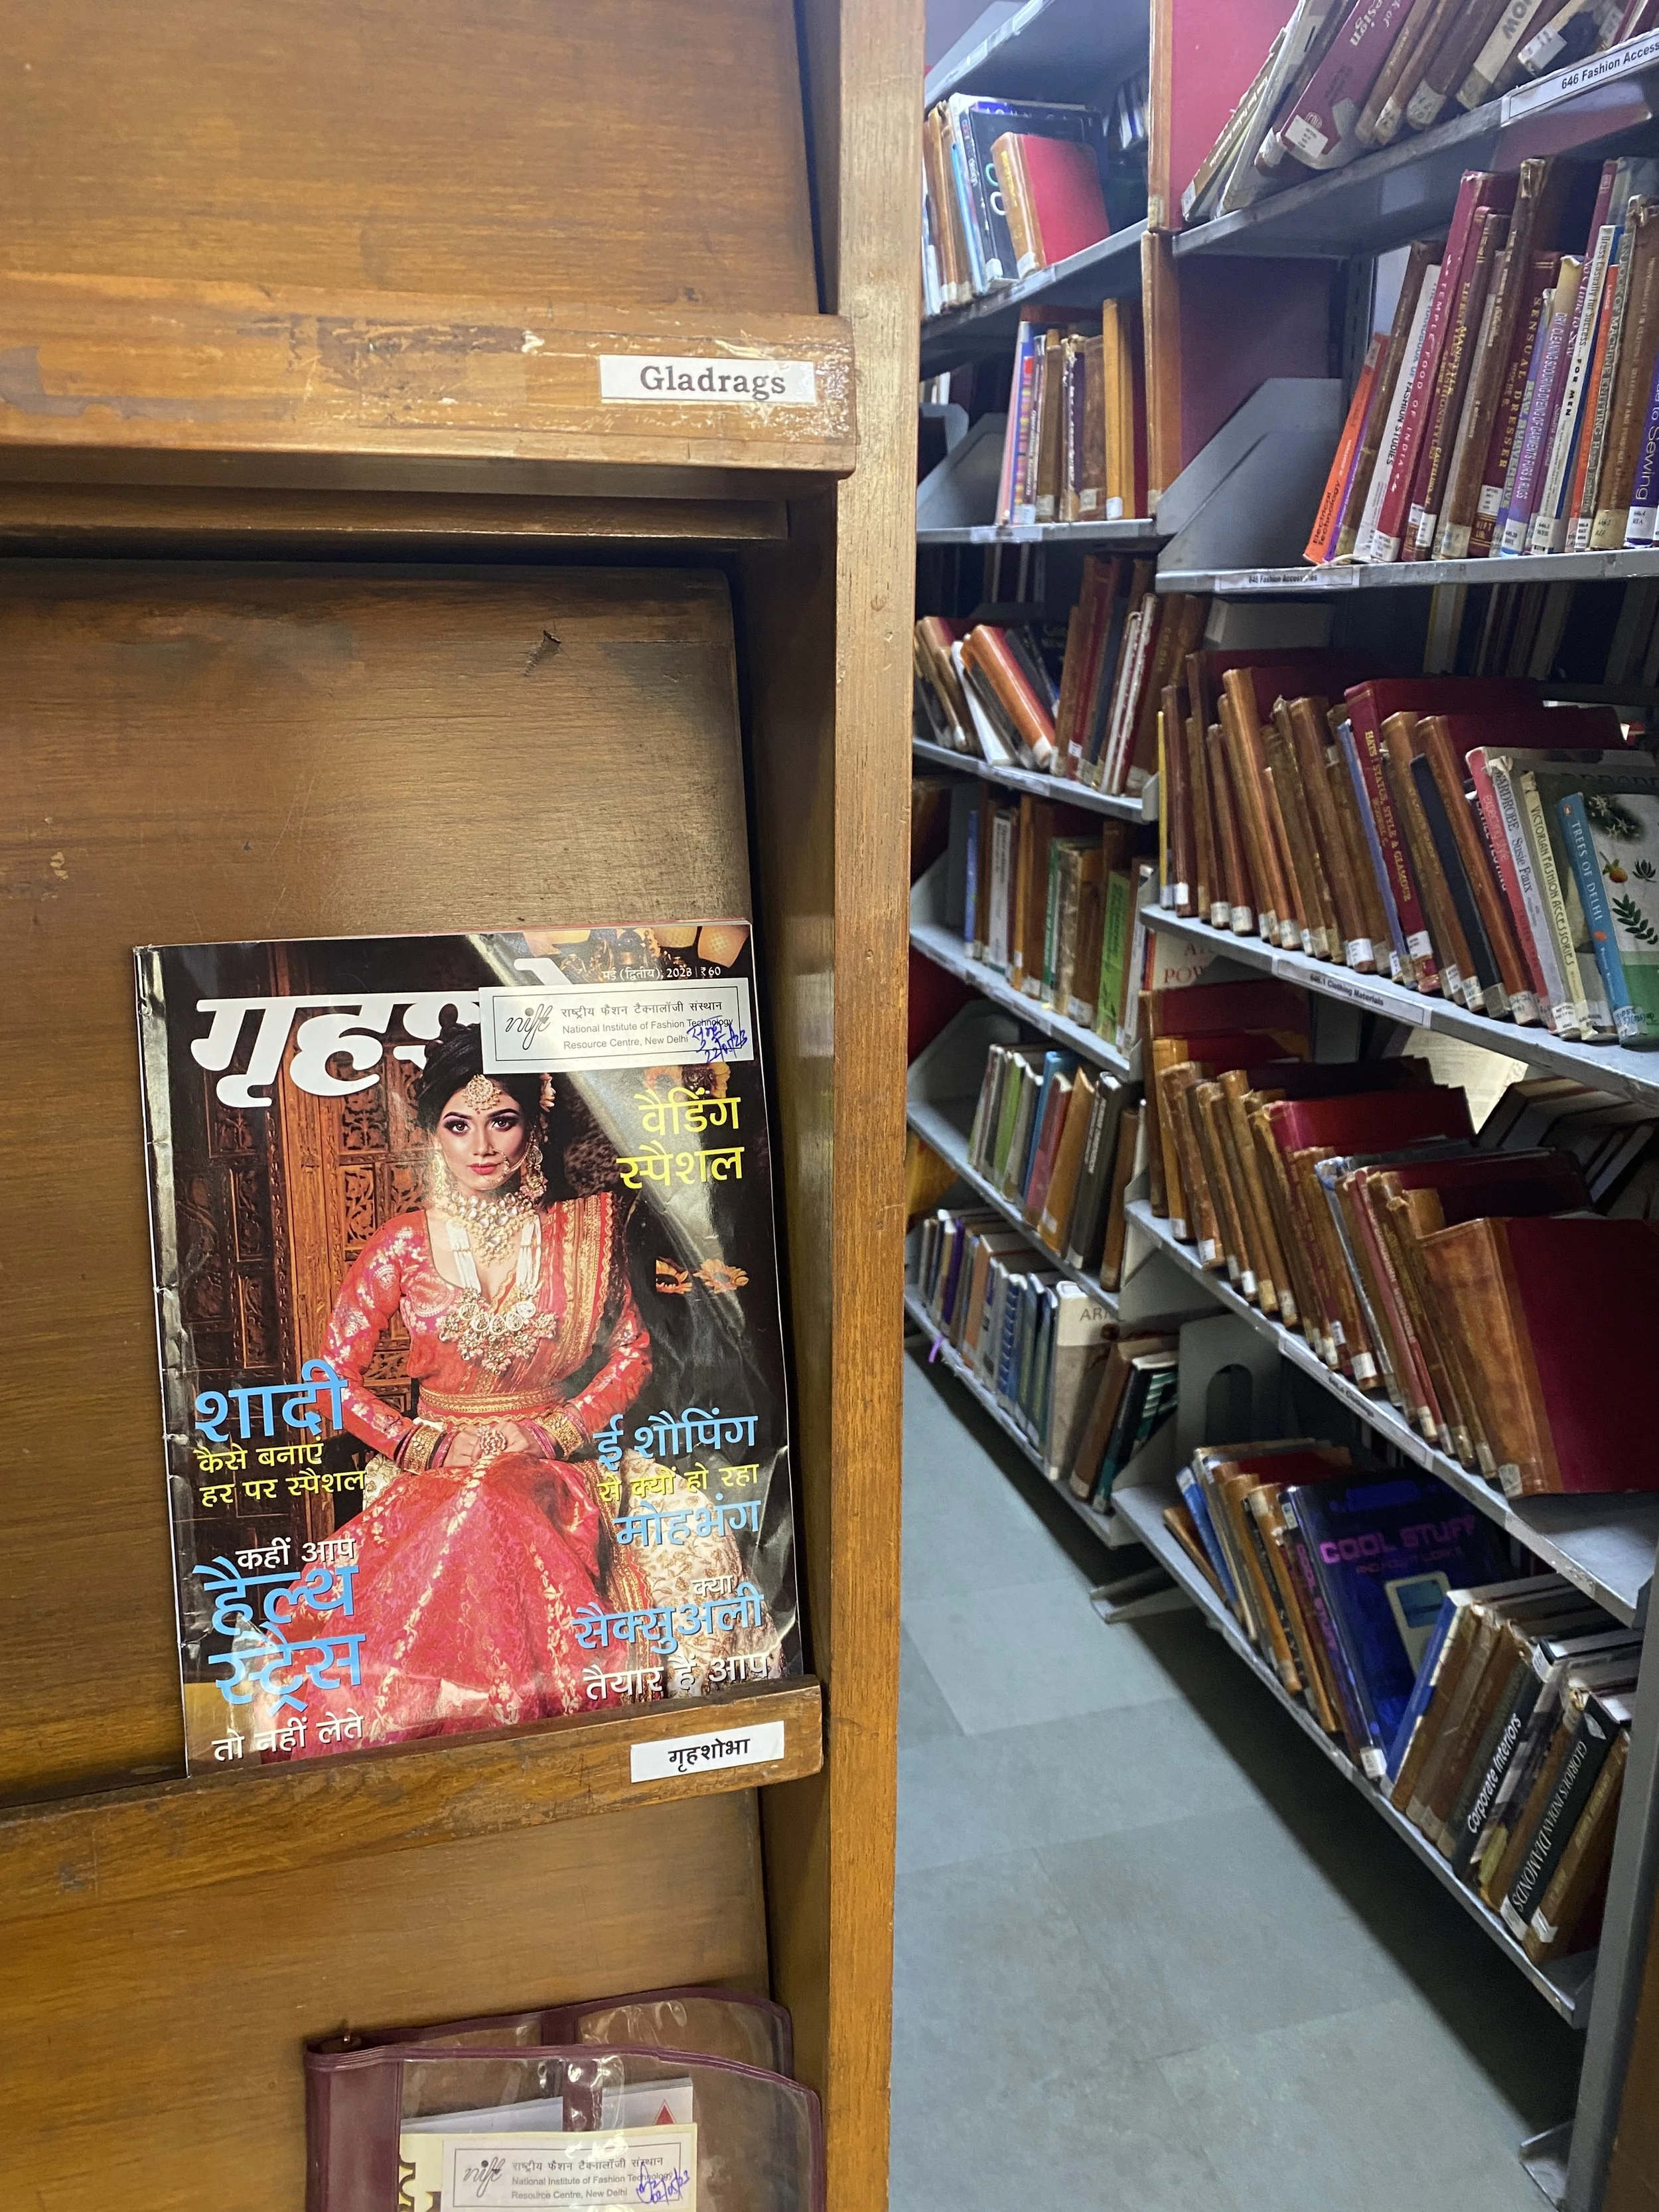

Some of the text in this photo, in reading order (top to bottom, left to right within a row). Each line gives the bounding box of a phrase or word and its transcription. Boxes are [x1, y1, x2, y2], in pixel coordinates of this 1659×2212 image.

[1561, 73, 1579, 90] 646
[1582, 58, 1620, 82] Fashion
[1588, 261, 1606, 297] Casually
[1546, 327, 1563, 360] CLEANING
[1603, 316, 1620, 374] MACHINE
[640, 364, 786, 400] Gladrags
[1397, 282, 1447, 466] TEMPLE FOOD OF INDIA
[1498, 296, 1542, 469] SENSUAL DRESSER
[1571, 358, 1582, 383] FOR
[1397, 380, 1412, 422] FASHION
[1564, 390, 1575, 417] MEN
[1593, 376, 1610, 435] KNITTING
[1386, 425, 1402, 465] STUDIES
[1524, 425, 1542, 459] GARMENTS
[1636, 425, 1659, 500] Sewing
[1520, 459, 1534, 475] FURS
[1514, 481, 1529, 499] RUGS
[1313, 492, 1331, 544] Electrical
[1318, 480, 1340, 546] Technology
[1261, 574, 1281, 583] Fashion
[1282, 574, 1317, 583] Accessies
[1365, 731, 1377, 757] HATS
[1383, 806, 1397, 838] STYLE
[1479, 794, 1512, 862] expecting style
[1529, 806, 1550, 855] VICTORIAN
[1511, 837, 1528, 865] Susie
[1571, 820, 1603, 921] TREES OF DELHI
[1518, 866, 1535, 893] Faux
[1541, 856, 1560, 897] FASHION
[1550, 899, 1576, 965] ACCESSORIES
[602, 970, 616, 982] मई
[1328, 980, 1353, 995] Clothing
[1354, 989, 1384, 1005] Materials
[561, 1006, 595, 1019] राष्ट्रीय
[600, 1003, 628, 1015] फैशन
[689, 999, 722, 1013] संस्थान
[562, 1017, 733, 1034] National Institute of Fashion Technology
[563, 1034, 688, 1050] Resource Centre, New Delhi
[636, 1087, 739, 1136] वैडिंग
[616, 1142, 743, 1189] स्पैशल
[195, 1359, 349, 1443] शादी
[193, 1436, 324, 1475] कैसे बनाएं
[593, 1406, 758, 1471] ई शौपिंग
[200, 1468, 366, 1507] हर पर स्पैशल
[597, 1462, 759, 1503] से क्यों हो रहा
[614, 1493, 762, 1547] मोहभंग
[235, 1536, 356, 1570] कहीं आप
[1319, 1532, 1397, 1564] COOL
[192, 1556, 360, 1636] हैल्थ
[691, 1575, 733, 1598] क्या
[571, 1581, 764, 1655] सैक्सुअली
[208, 1621, 367, 1718] स्ट्रेस
[582, 1652, 770, 1700] तैयार हैं आप
[212, 1708, 364, 1762] तो नहीं लेते
[668, 1737, 751, 1773] गृहशोभा
[1468, 1712, 1522, 1834] Corporate Interiors
[1559, 1740, 1587, 1798] GLORIOUS
[1512, 1832, 1551, 1913] DIAMONDS
[512, 2160, 543, 2172] राष्ट्रीय
[547, 2159, 573, 2171] फैशन
[631, 2156, 664, 2168] संस्थान
[512, 2172, 673, 2185] National Institute of Fashion Technology
[512, 2187, 627, 2200] Resource Centre, New Delhi
